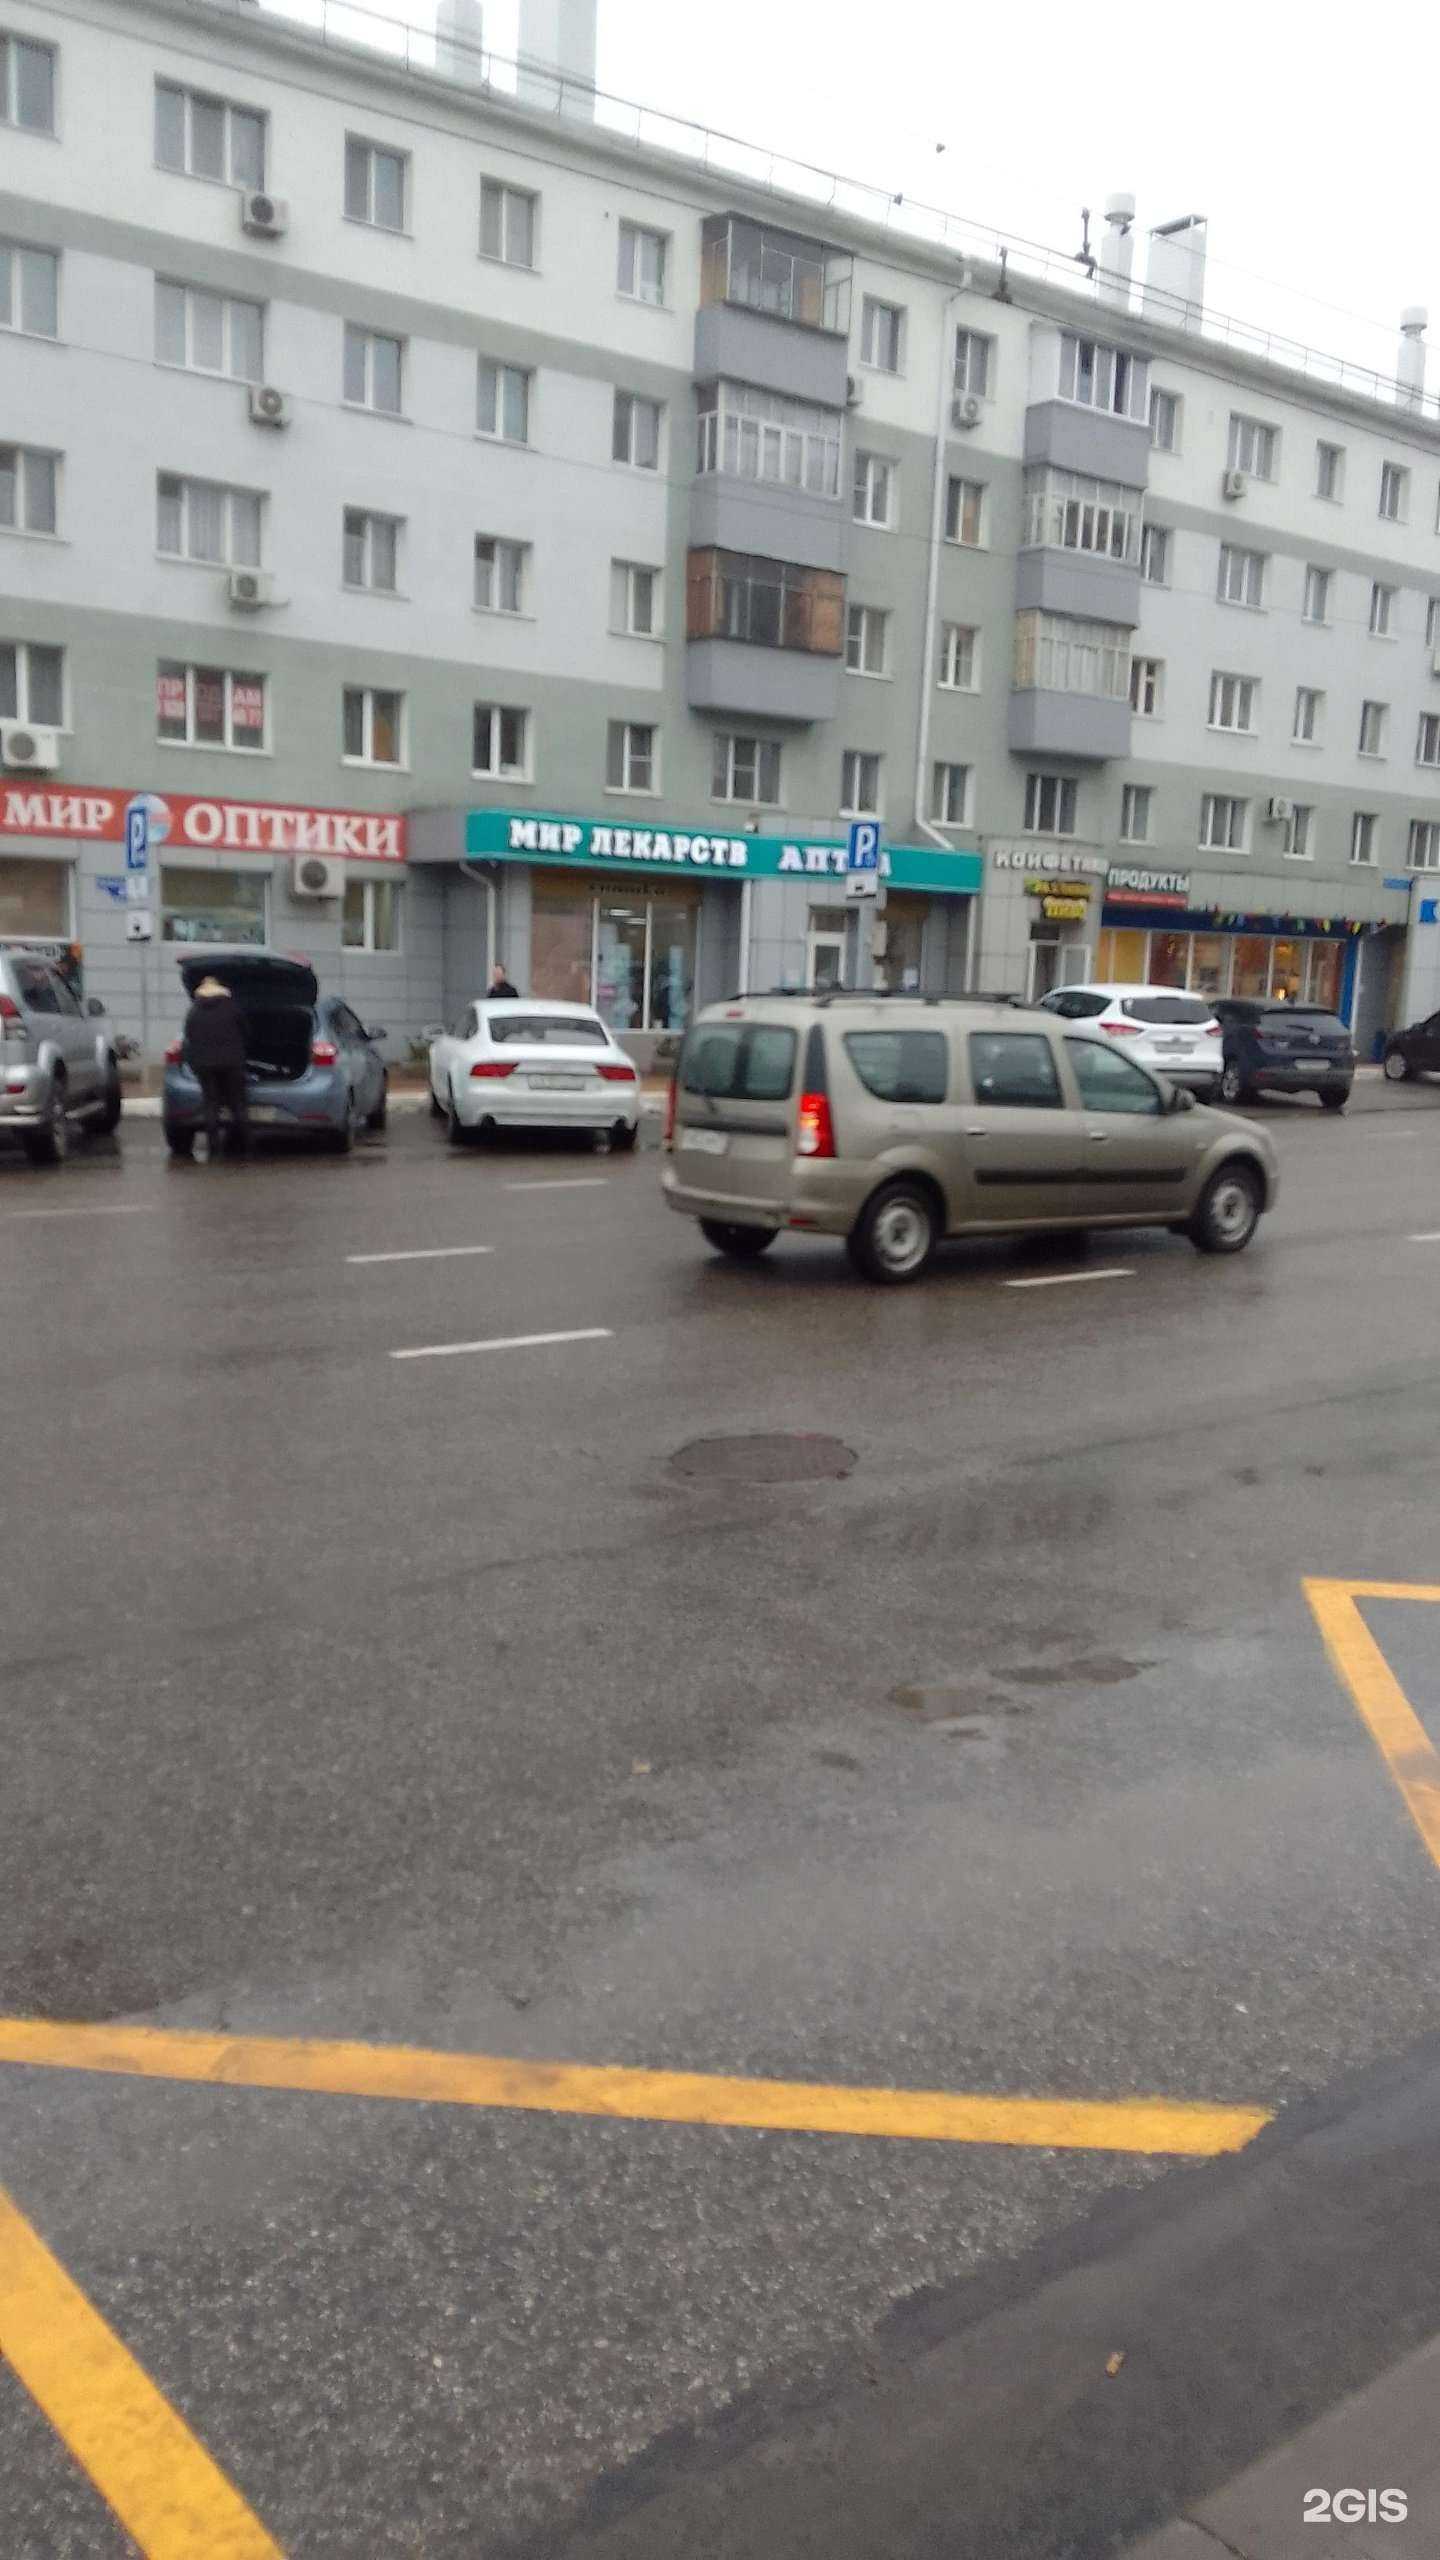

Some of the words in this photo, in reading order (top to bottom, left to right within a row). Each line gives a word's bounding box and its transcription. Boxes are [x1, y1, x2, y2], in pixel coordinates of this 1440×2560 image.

[2, 792, 114, 832] МИР
[183, 802, 400, 857] ОПТИКИ
[510, 818, 583, 853] МИР
[590, 826, 748, 867] ЛЕКАРСТВ
[778, 845, 892, 877] АПТА
[1108, 867, 1190, 893] ПРОДУКТЫ
